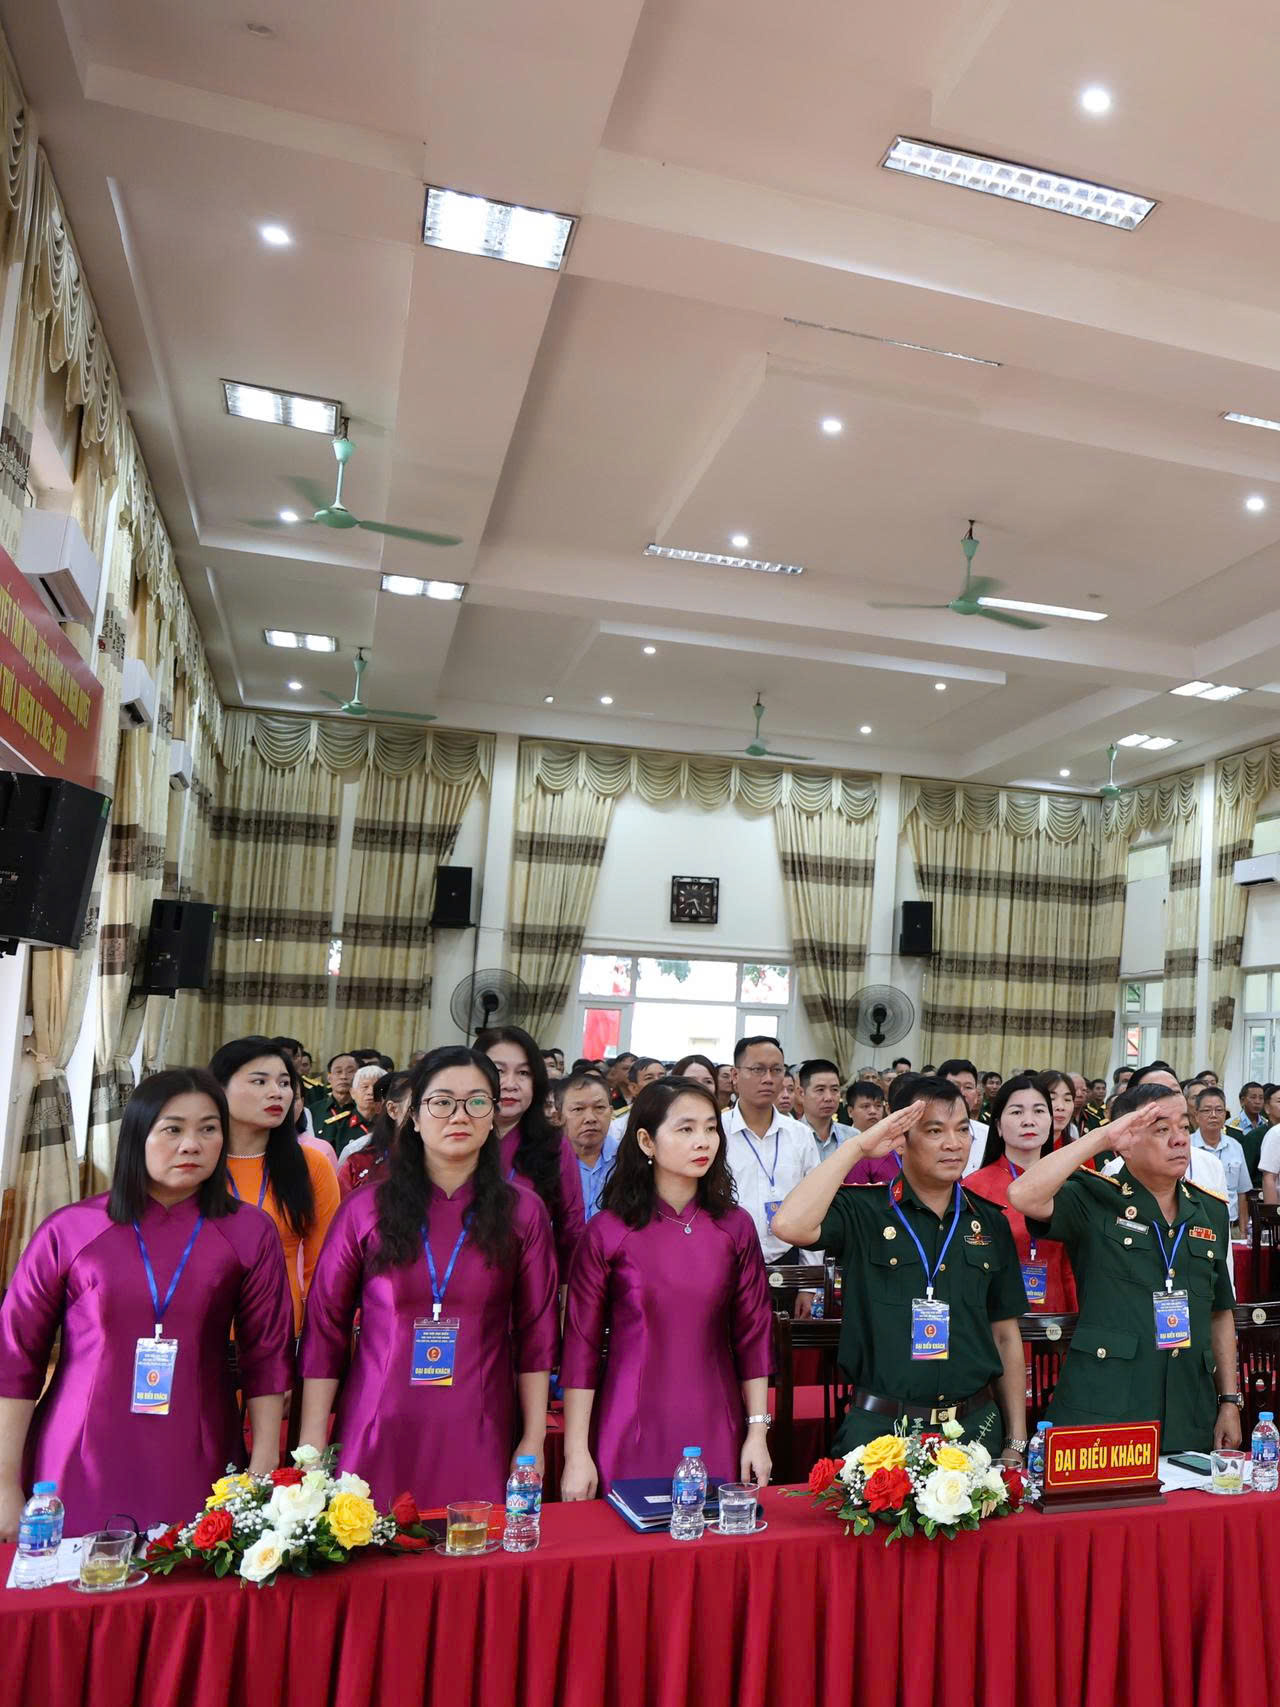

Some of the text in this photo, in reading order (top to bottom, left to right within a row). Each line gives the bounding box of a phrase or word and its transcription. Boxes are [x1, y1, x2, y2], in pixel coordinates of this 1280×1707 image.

[1055, 1438, 1151, 1477] ĐẠI BIỂU KHÁCH
